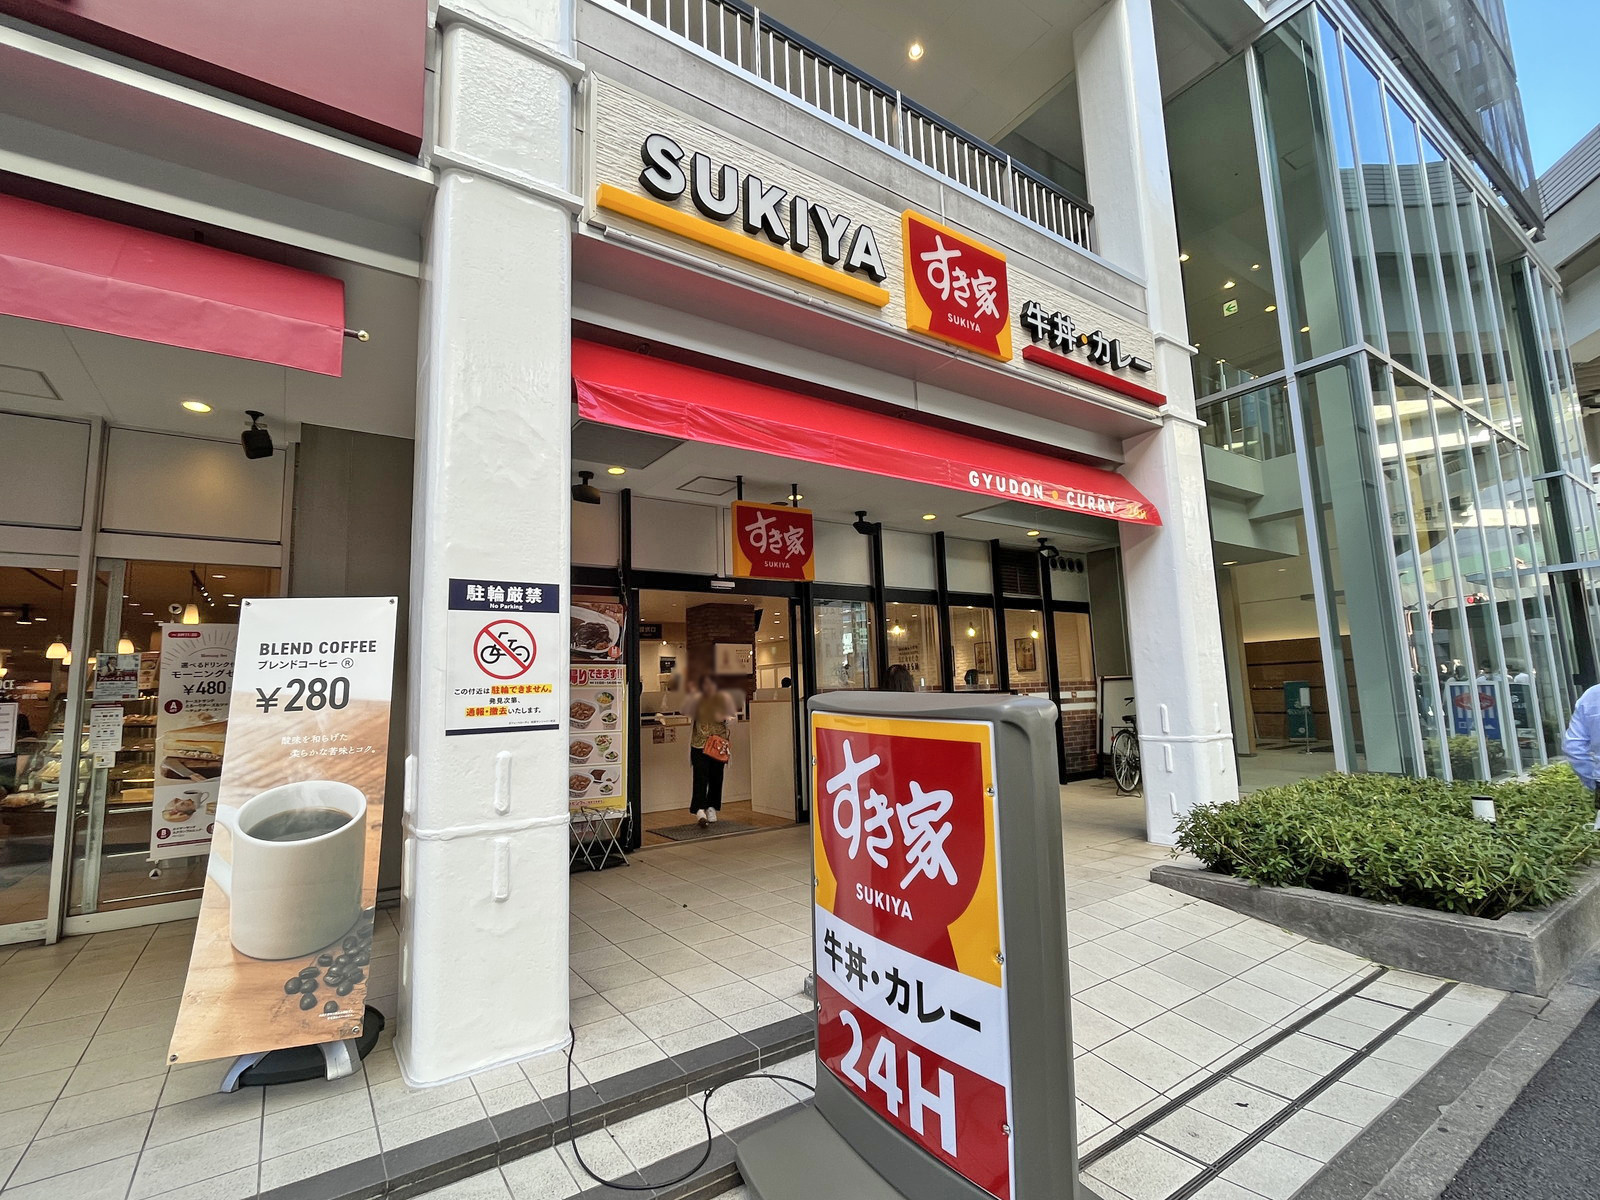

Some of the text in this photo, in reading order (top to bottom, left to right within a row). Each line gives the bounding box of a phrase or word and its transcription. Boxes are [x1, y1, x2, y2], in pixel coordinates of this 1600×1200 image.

[639, 134, 887, 283] SUKIYA
[920, 234, 1000, 319] すき家
[947, 312, 982, 334] SUKIYA
[968, 470, 1044, 500] GYUDON
[1066, 491, 1116, 514] CURRY
[744, 510, 806, 560] すき家
[764, 560, 790, 569] SUKIYA
[466, 584, 543, 604] 駐輪厳禁
[500, 603, 524, 611] Parking
[259, 640, 377, 656] BLEND COFFEE
[258, 659, 338, 670] ブレンドコーヒー
[183, 680, 227, 696] ¥480
[255, 676, 350, 714] ¥280
[281, 733, 348, 746] 酸味を和らげた
[289, 745, 377, 759] 柔らかな苦味とコク。
[826, 738, 958, 889] すき家
[855, 882, 913, 922] SUKIYA
[823, 929, 982, 1033] 牛丼・カレー
[839, 1008, 958, 1159] 24H
